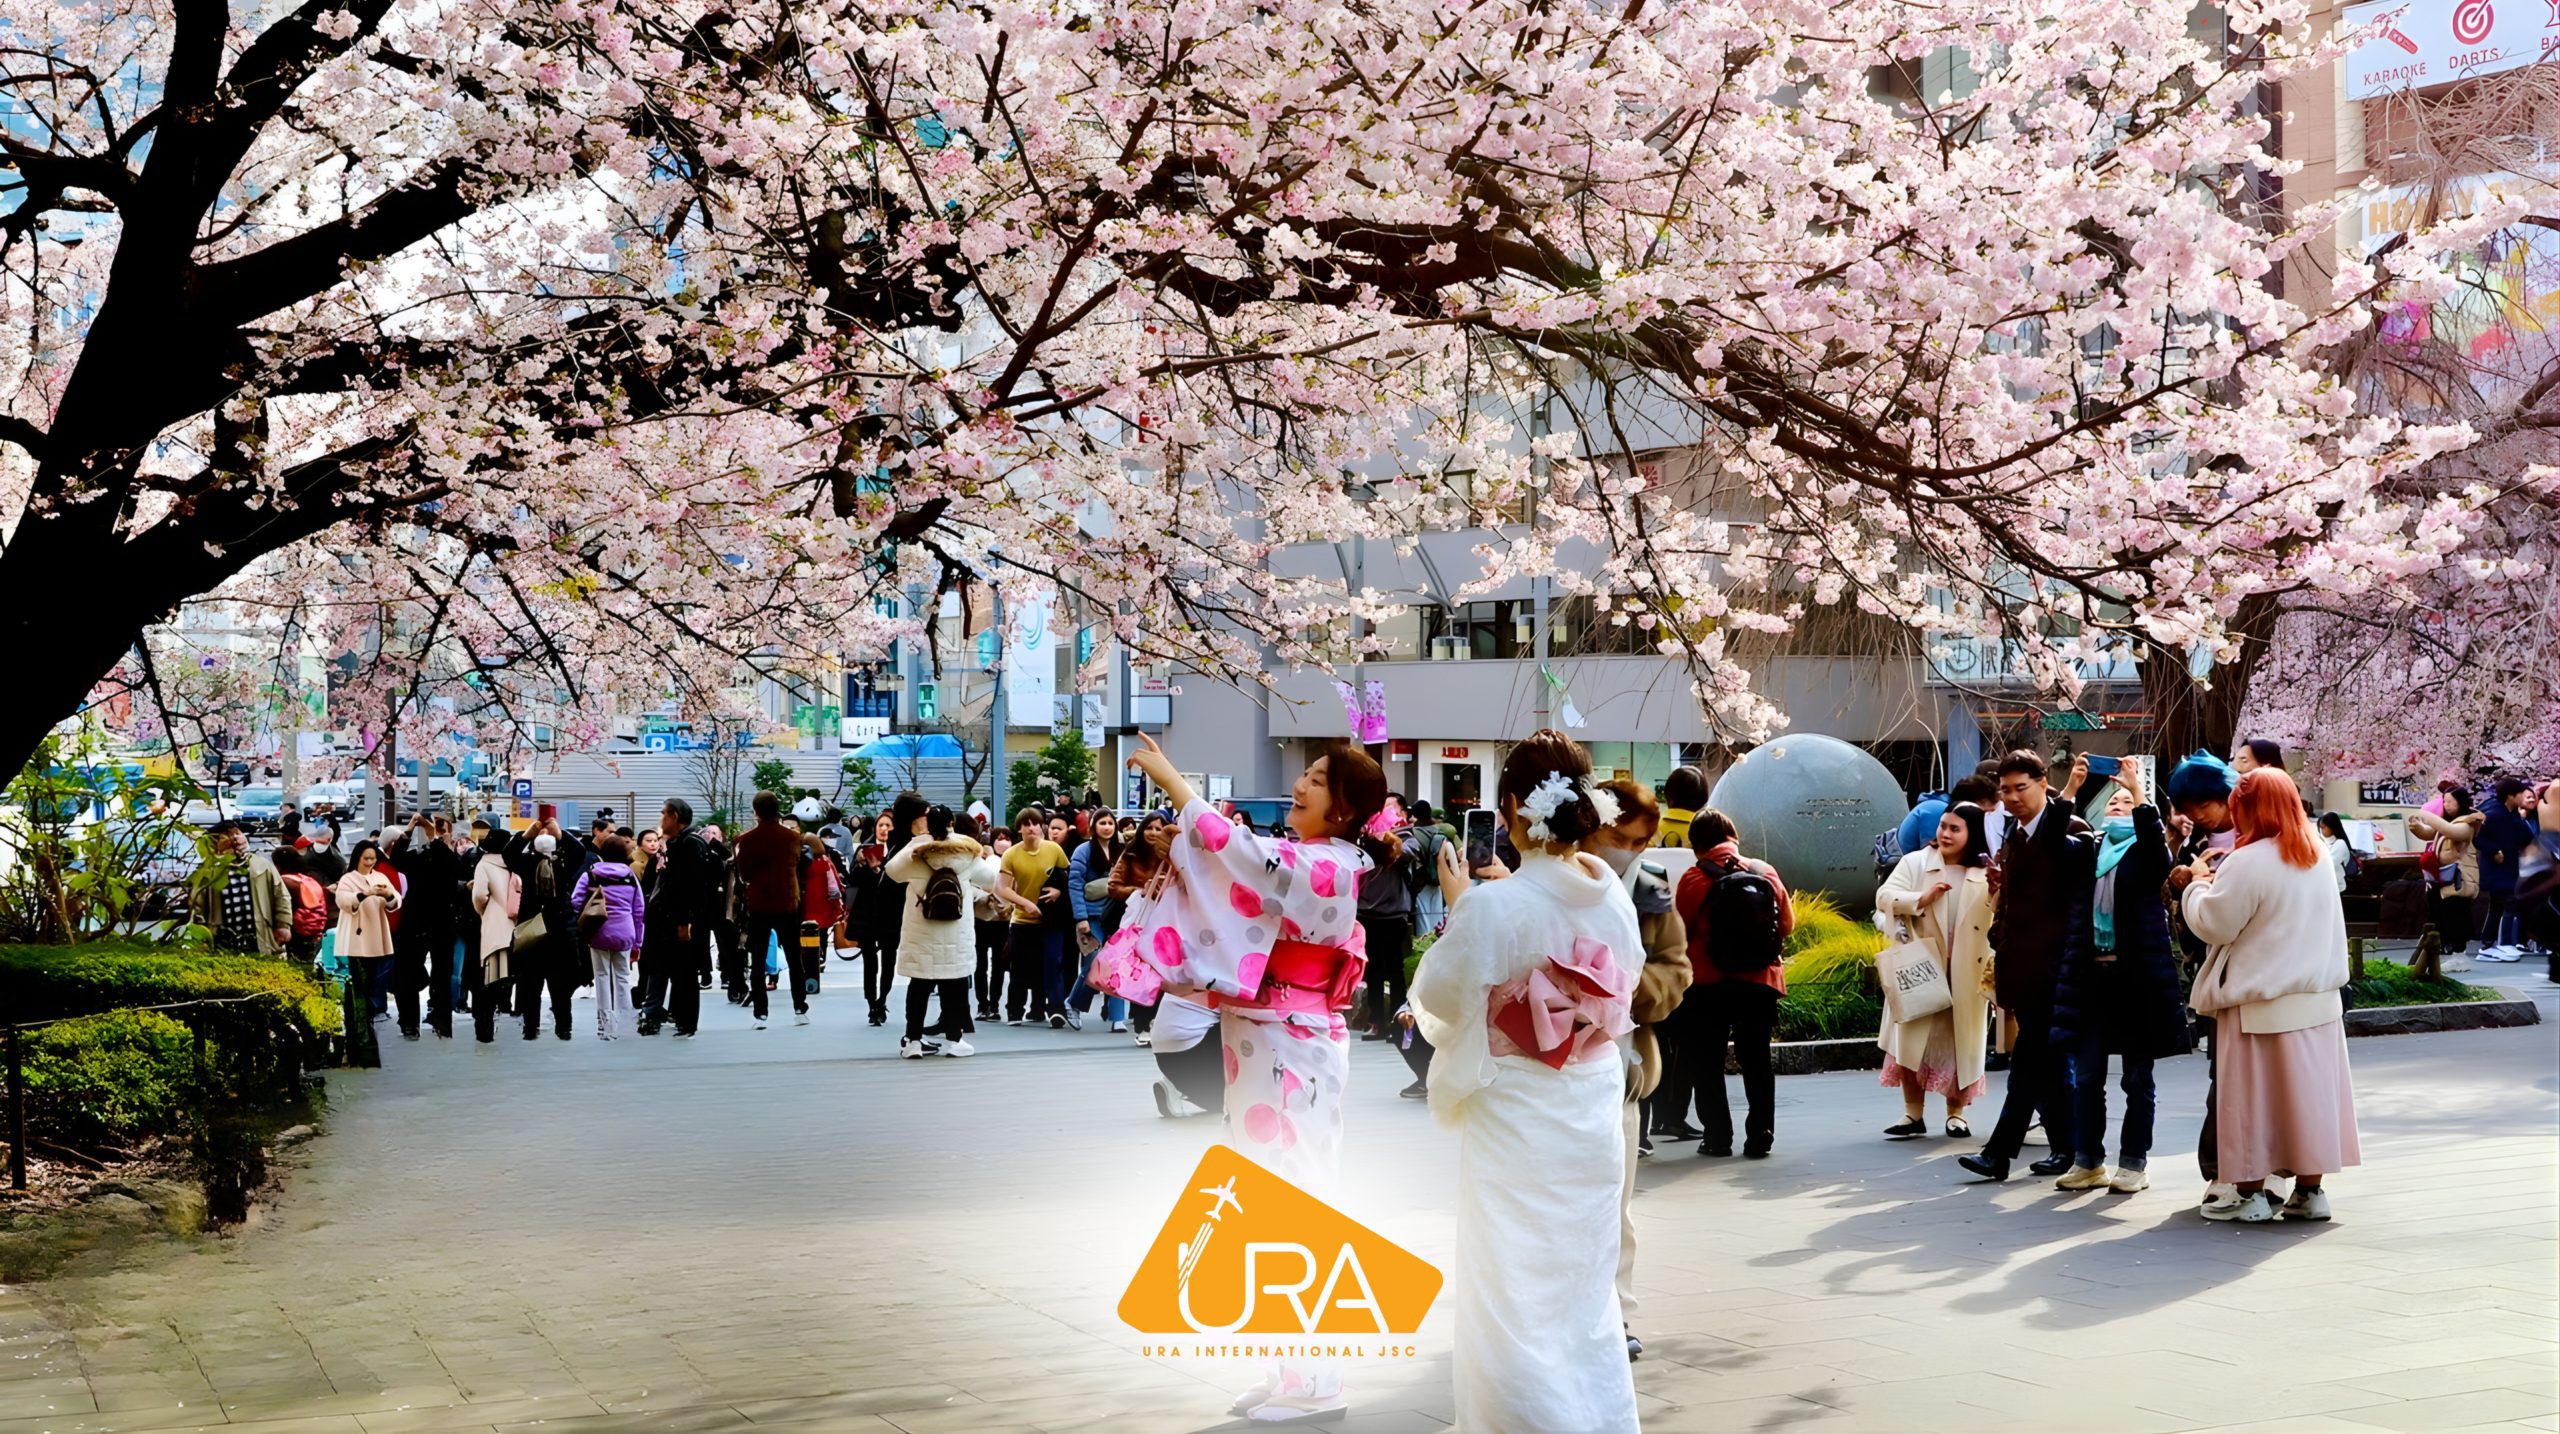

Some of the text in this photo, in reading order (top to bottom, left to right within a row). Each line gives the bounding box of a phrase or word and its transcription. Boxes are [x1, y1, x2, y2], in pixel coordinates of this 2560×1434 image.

[2449, 48, 2499, 69] DARTS
[2364, 62, 2427, 86] KARAOKE
[516, 782, 530, 796] P
